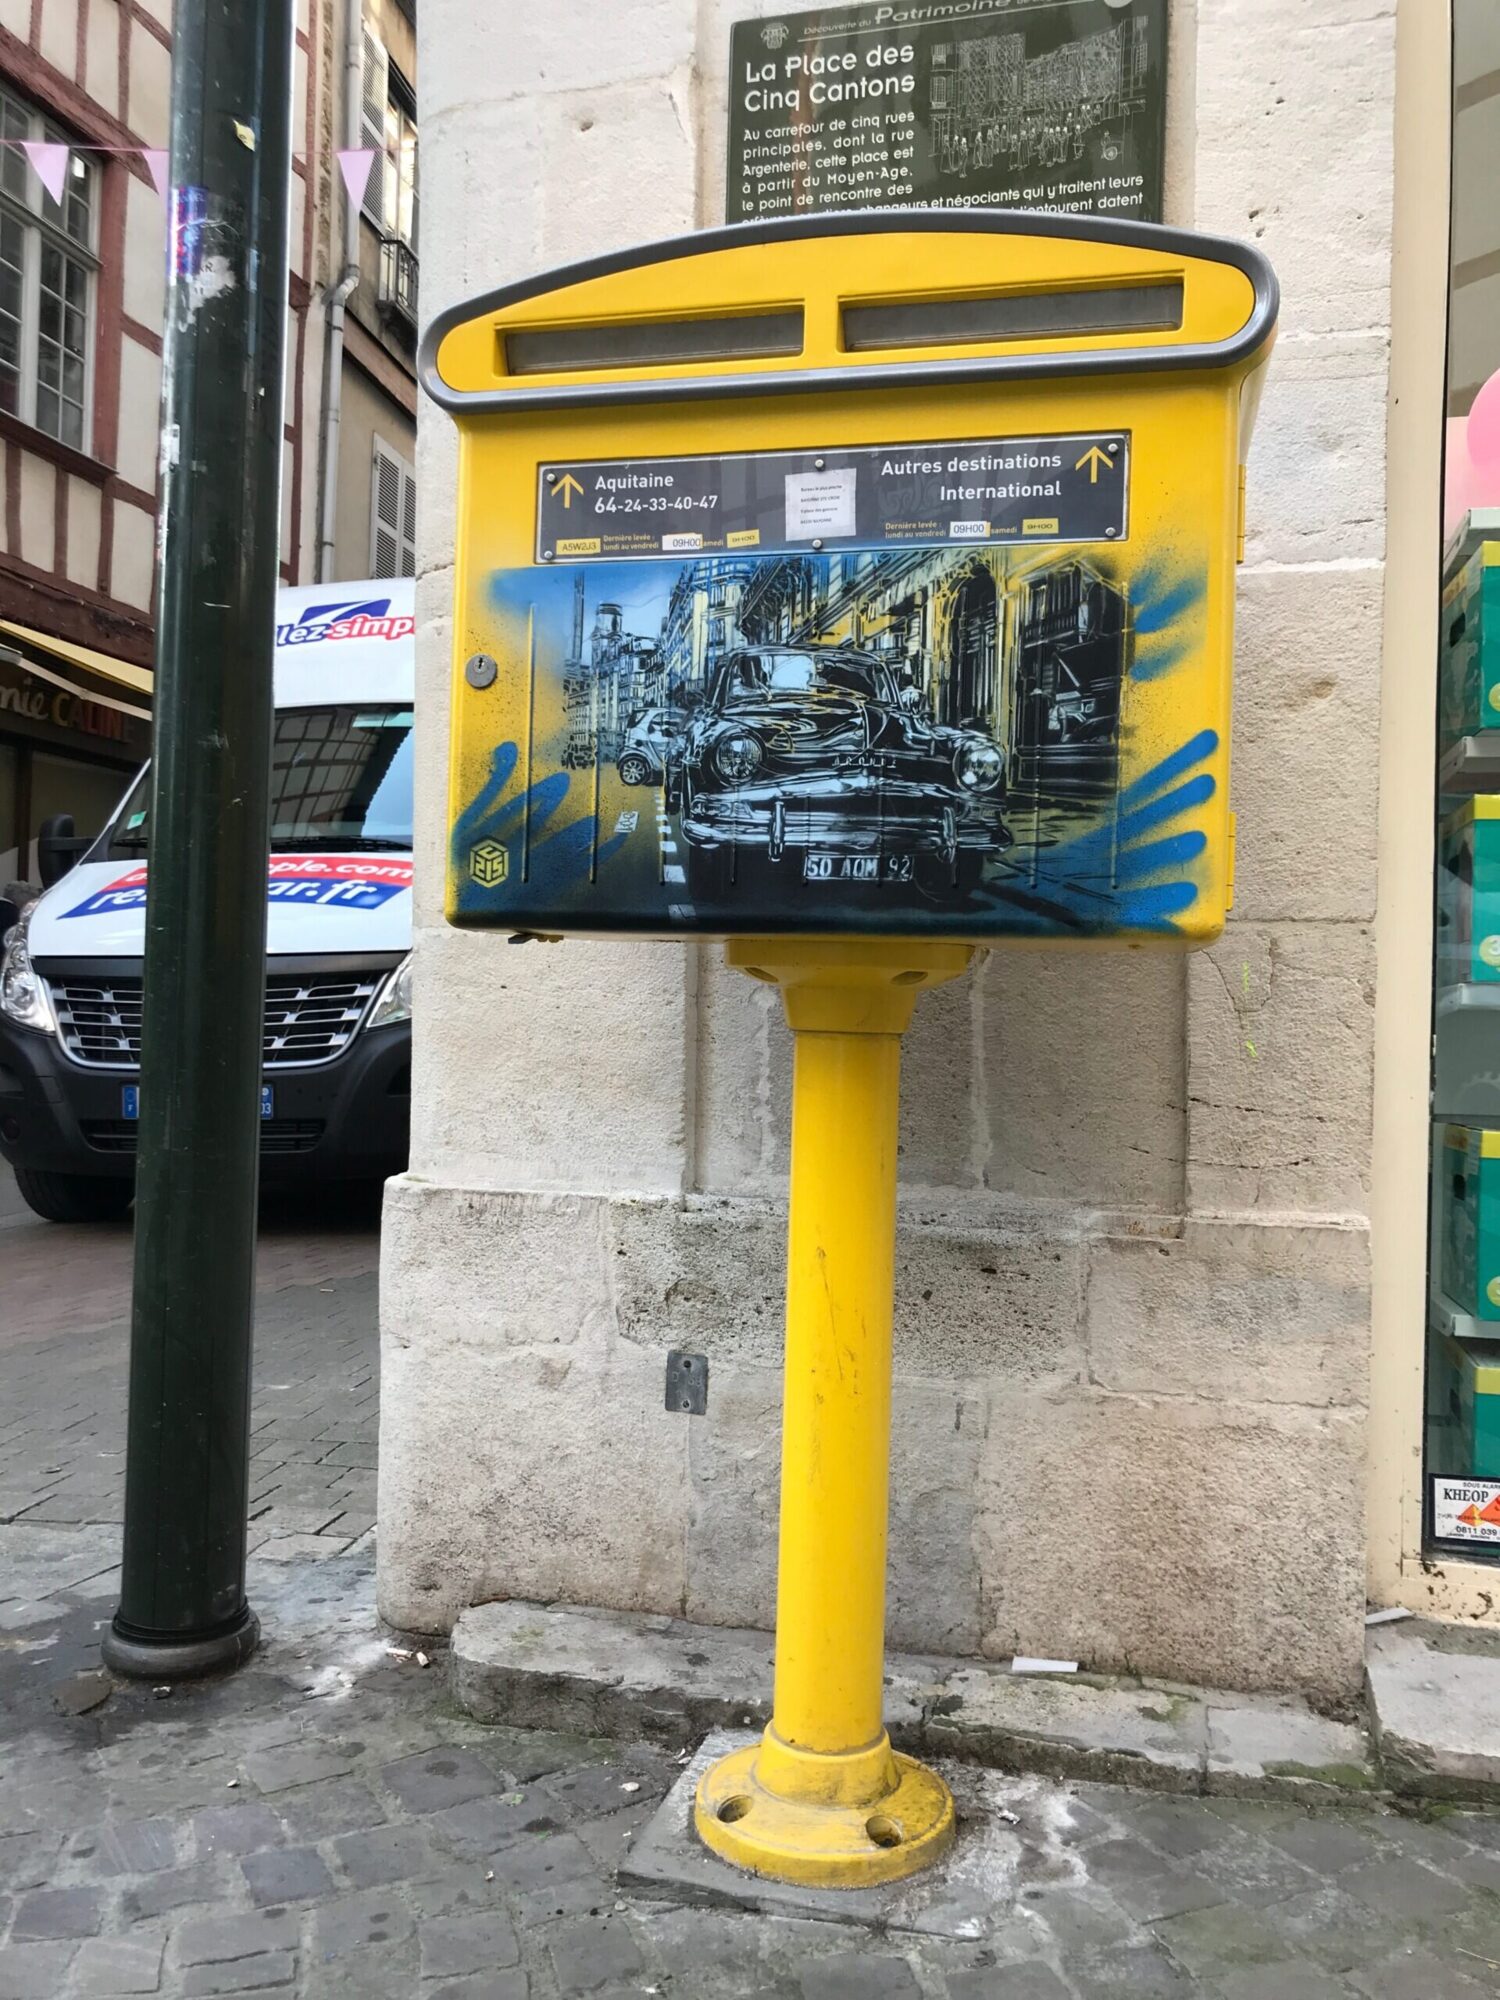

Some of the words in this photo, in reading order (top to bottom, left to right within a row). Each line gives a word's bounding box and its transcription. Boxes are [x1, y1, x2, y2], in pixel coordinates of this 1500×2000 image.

[859, 20, 871, 30] du
[746, 62, 776, 83] La
[785, 53, 857, 78] Place
[866, 45, 915, 67] des
[745, 88, 800, 112] Cinq
[809, 74, 916, 104] Cantons
[743, 129, 760, 141] Au
[765, 122, 825, 138] carrefour
[829, 119, 846, 131] de
[852, 115, 880, 129] cinq
[885, 111, 915, 124] rues
[743, 143, 826, 161] principales,
[834, 134, 865, 149] dont
[871, 132, 885, 144] la
[891, 129, 914, 142] rue
[742, 159, 811, 178] Argenterie,
[815, 154, 847, 168] cette
[851, 149, 889, 167] place
[893, 146, 914, 160] est
[742, 181, 751, 194] à
[757, 178, 796, 195] partir
[802, 175, 820, 188] du
[931, 196, 943, 208] et
[946, 189, 1020, 208] négociants
[1023, 184, 1044, 200] qui
[1048, 185, 1055, 199] y
[1059, 177, 1106, 194] traitent
[1108, 174, 1143, 189] leurs
[742, 200, 754, 211] le
[759, 195, 792, 212] point
[797, 193, 814, 206] de
[819, 186, 882, 203] rencontre
[887, 183, 913, 196] des
[1098, 192, 1143, 208] datent
[881, 460, 942, 475] Autres
[947, 453, 1062, 473] destinations
[595, 473, 674, 492] Aquitaine
[940, 481, 1062, 500] International
[595, 495, 718, 513] 64-24-33-40-47
[885, 522, 917, 530] Dernière
[918, 521, 937, 529] levée
[885, 531, 902, 539] lundi
[915, 530, 946, 538] vendredi
[953, 523, 985, 534] 09H00
[991, 526, 1017, 534] samedi
[603, 534, 632, 542] Dernière
[633, 533, 650, 541] levée
[603, 543, 619, 551] lundi
[630, 541, 659, 550] vendredi
[672, 537, 701, 548] 09H00
[888, 855, 911, 878] 92
[1443, 1488, 1489, 1503] KHEOP
[1456, 1525, 1477, 1534] 0811
[1481, 1528, 1497, 1536] 039
